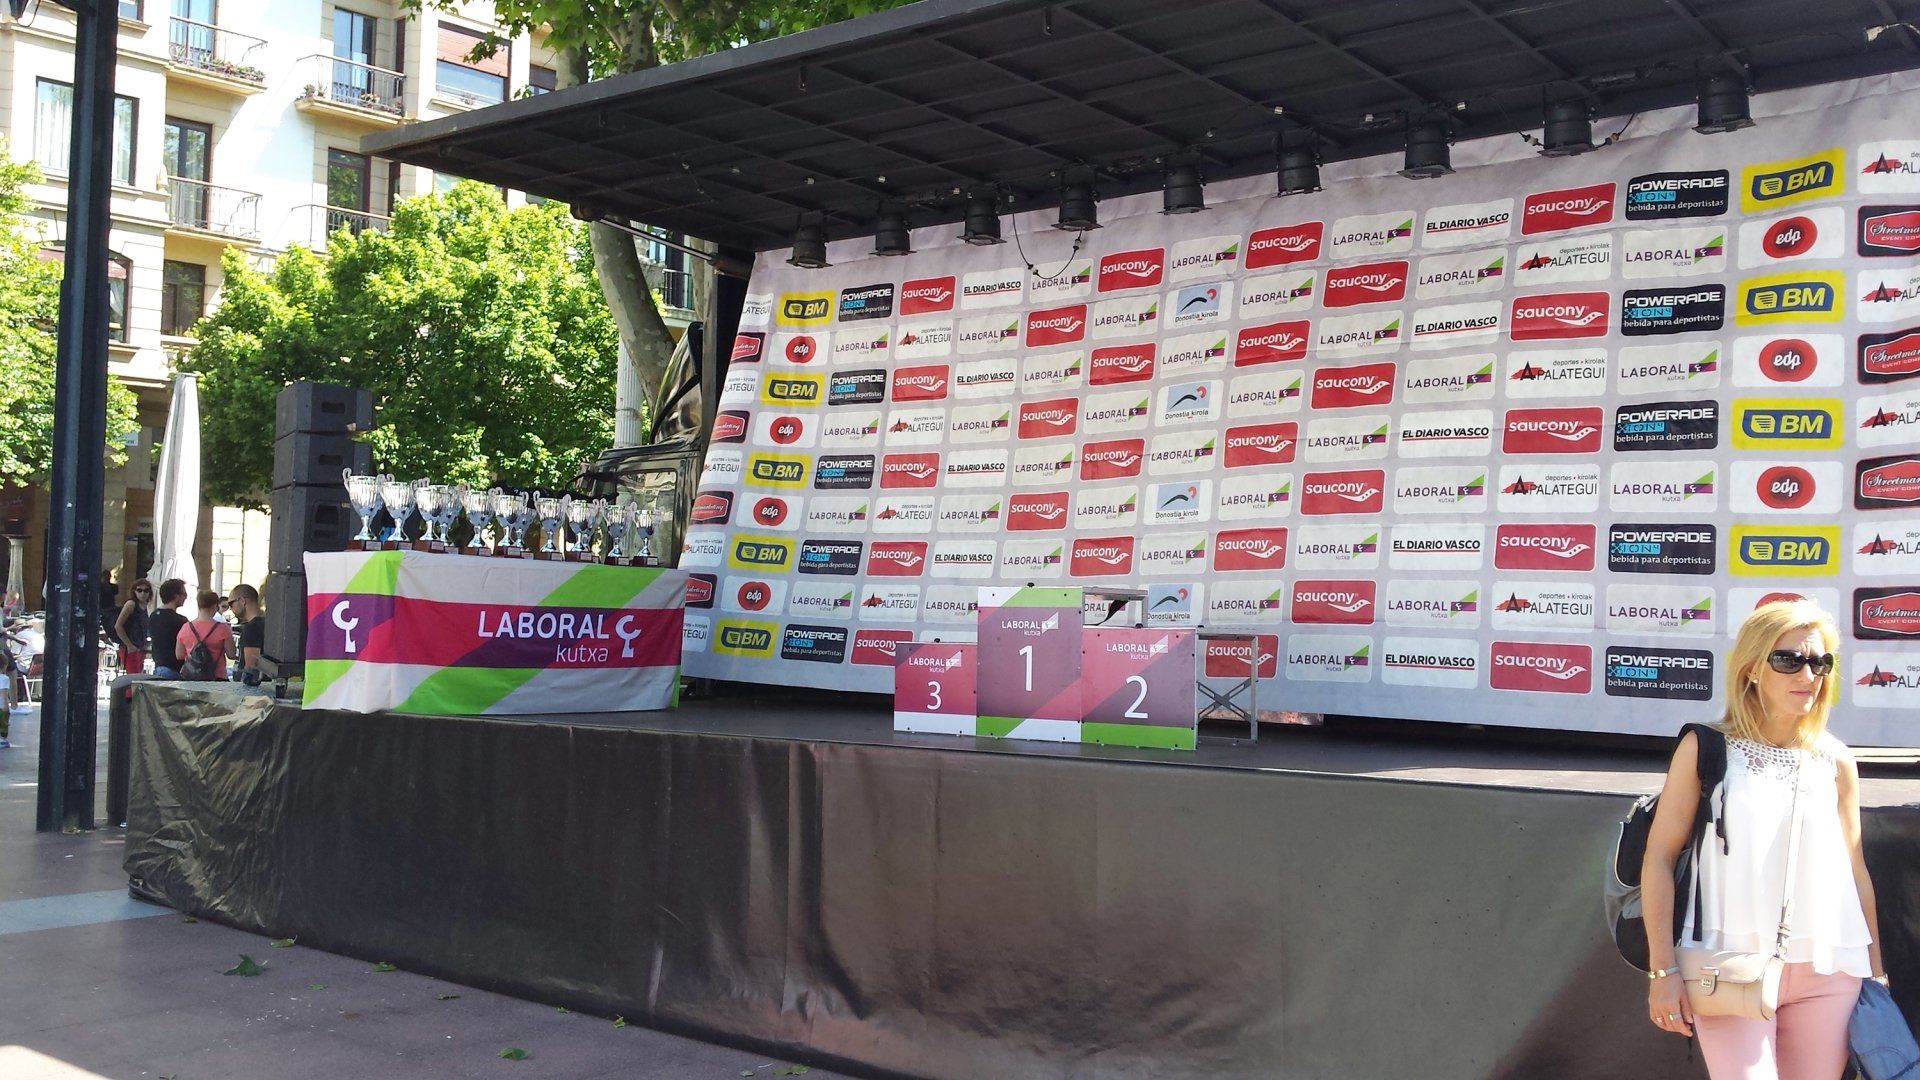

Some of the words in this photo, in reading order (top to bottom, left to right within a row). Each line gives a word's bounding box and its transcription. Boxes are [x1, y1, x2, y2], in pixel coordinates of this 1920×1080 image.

[1628, 177, 1725, 193] POWERADE
[1786, 167, 1826, 192] BM
[1528, 197, 1594, 215] saucony
[1628, 202, 1655, 212] bebida
[1657, 201, 1675, 212] para
[1678, 198, 1725, 210] deportistas
[1426, 222, 1438, 231] EL
[1439, 218, 1475, 229] DIARIO
[1477, 212, 1509, 226] VASCO
[1251, 234, 1303, 250] saucony
[1333, 231, 1385, 246] LABORAL
[1775, 228, 1801, 246] edp
[1626, 248, 1692, 263] LABORAL
[1101, 261, 1149, 275] saucony
[1329, 274, 1387, 288] saucony
[1419, 270, 1475, 285] LABORAL
[1624, 290, 1721, 308] POWERADE
[1781, 287, 1825, 308] BM
[1515, 304, 1586, 321] saucony
[1030, 317, 1072, 330] saucony
[1415, 324, 1427, 333] EL
[1427, 321, 1462, 332] DIARIO
[1464, 316, 1498, 328] VASCO
[1624, 319, 1651, 328] bebida
[1653, 317, 1671, 328] para
[1673, 313, 1720, 326] deportistas
[1239, 332, 1290, 347] saucony
[1320, 331, 1372, 345] LABORAL
[1093, 355, 1141, 368] saucony
[1773, 350, 1802, 370] edp
[1621, 363, 1686, 379] LABORAL
[831, 374, 884, 385] POWERADE
[895, 375, 936, 387] saucony
[1316, 375, 1374, 390] saucony
[1407, 376, 1465, 389] LABORAL
[789, 383, 815, 397] BM
[1230, 391, 1277, 404] LABORAL
[1021, 409, 1064, 422] saucony
[1165, 410, 1190, 420] Donostia
[1191, 408, 1209, 417] kirola
[1617, 408, 1715, 424] POWERADE
[778, 424, 795, 436] edp
[1508, 420, 1580, 435] saucony
[1779, 416, 1824, 434] BM
[1402, 430, 1415, 439] EL
[1415, 428, 1452, 438] DIARIO
[1454, 427, 1489, 436] VASCO
[1616, 434, 1643, 443] bebida
[1646, 433, 1664, 444] para
[1667, 431, 1714, 442] deportistas
[1227, 434, 1280, 449] saucony
[1308, 435, 1361, 448] LABORAL
[1084, 450, 1129, 463] saucony
[773, 464, 799, 478] BM
[818, 460, 873, 469] POWERADE
[884, 462, 926, 474] saucony
[947, 464, 956, 472] EL
[956, 463, 980, 472] DIARIO
[981, 462, 1005, 470] VASCO
[1305, 482, 1365, 496] saucony
[1397, 487, 1455, 498] LABORAL
[1613, 483, 1681, 495] LABORAL
[1772, 479, 1799, 497] edp
[1221, 494, 1266, 506] LABORAL
[761, 505, 779, 518] edp
[1011, 502, 1055, 513] saucony
[1077, 504, 1117, 515] LABORAL
[1155, 510, 1181, 519] Donostia
[1182, 509, 1199, 517] kirola
[809, 511, 847, 520] LABORAL
[940, 510, 980, 520] LABORAL
[1500, 535, 1573, 549] saucony
[1611, 532, 1711, 543] POWERADE
[802, 545, 860, 554] POWERADE
[1217, 539, 1269, 552] saucony
[1298, 545, 1351, 555] LABORAL
[1393, 541, 1405, 550] EL
[1405, 540, 1443, 550] DIARIO
[1445, 540, 1481, 550] VASCO
[1777, 542, 1821, 561] BM
[757, 548, 784, 562] BM
[870, 549, 913, 562] saucony
[934, 554, 942, 562] EL
[943, 554, 968, 562] DIARIO
[968, 554, 993, 562] VASCO
[1074, 546, 1119, 558] saucony
[1142, 550, 1184, 561] LABORAL
[1003, 555, 1042, 565] LABORAL
[1611, 555, 1639, 564] bebida
[1641, 556, 1660, 566] para
[1662, 556, 1711, 566] deportistas
[746, 589, 762, 602] edp
[792, 596, 832, 606] LABORAL
[1295, 591, 1355, 604] saucony
[925, 601, 967, 611] LABORAL
[1211, 600, 1258, 610] LABORAL
[1388, 600, 1448, 612] LABORAL
[1173, 612, 1191, 620] kirola
[1609, 606, 1678, 619] LABORAL
[478, 610, 609, 640] LABORAL
[1001, 620, 1040, 630] LABORAL
[742, 631, 766, 646] BM
[785, 630, 845, 642] POWERADE
[1023, 629, 1041, 637] kutxa
[856, 638, 897, 650] saucony
[1106, 643, 1149, 653] LABORAL
[556, 643, 609, 663] kutxa
[1130, 652, 1149, 660] kutxa
[1208, 646, 1252, 657] saucon
[908, 657, 945, 667] LABORAL
[1289, 654, 1342, 665] LABORAL
[1385, 654, 1398, 663] EL
[1398, 654, 1436, 665] DIARIO
[1438, 656, 1475, 667] VASCO
[1495, 655, 1568, 669] saucony
[1607, 654, 1709, 669] POWERADE
[929, 666, 945, 674] kutxa
[1019, 645, 1033, 692] 1
[1607, 678, 1636, 687] bebida
[1638, 681, 1658, 689] para
[1660, 681, 1708, 691] deportistas
[926, 680, 942, 710] 3
[1124, 675, 1149, 719] 2
